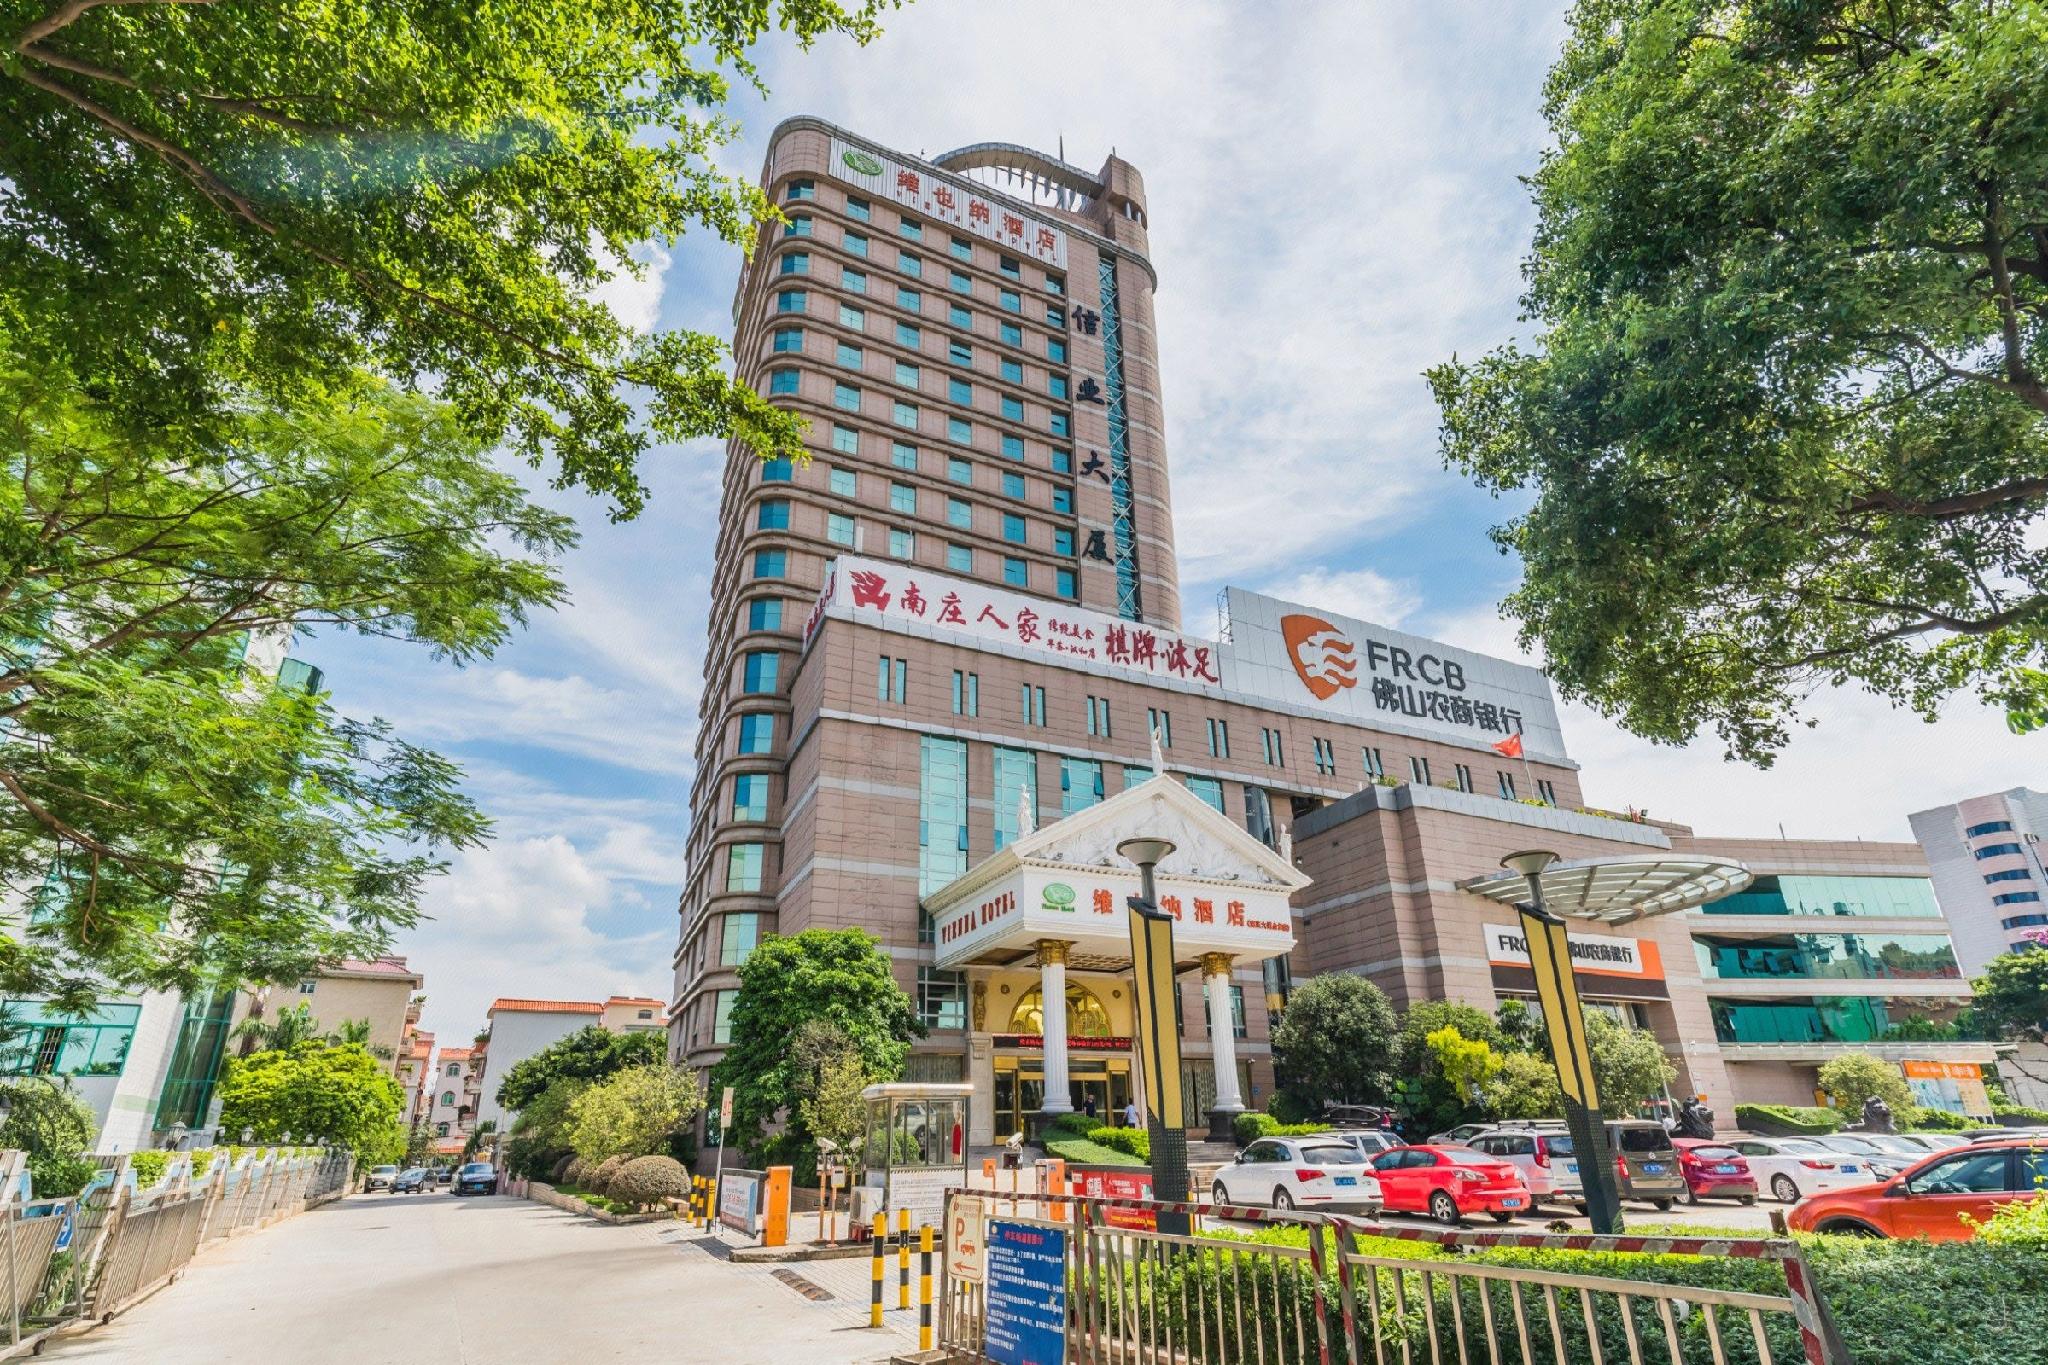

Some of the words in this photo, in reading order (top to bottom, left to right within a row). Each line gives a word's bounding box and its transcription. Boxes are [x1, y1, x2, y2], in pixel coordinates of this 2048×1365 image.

[898, 169, 1056, 253] 维也纳酒店
[1071, 304, 1114, 566] 信业大厦
[901, 581, 1041, 643] 南庄人家
[1366, 638, 1467, 692] FRCB
[1372, 676, 1524, 735] 佛山农商银行
[980, 890, 1016, 926] HOTEL
[1093, 888, 1246, 927] 维纳酒店
[955, 1217, 966, 1251] P
